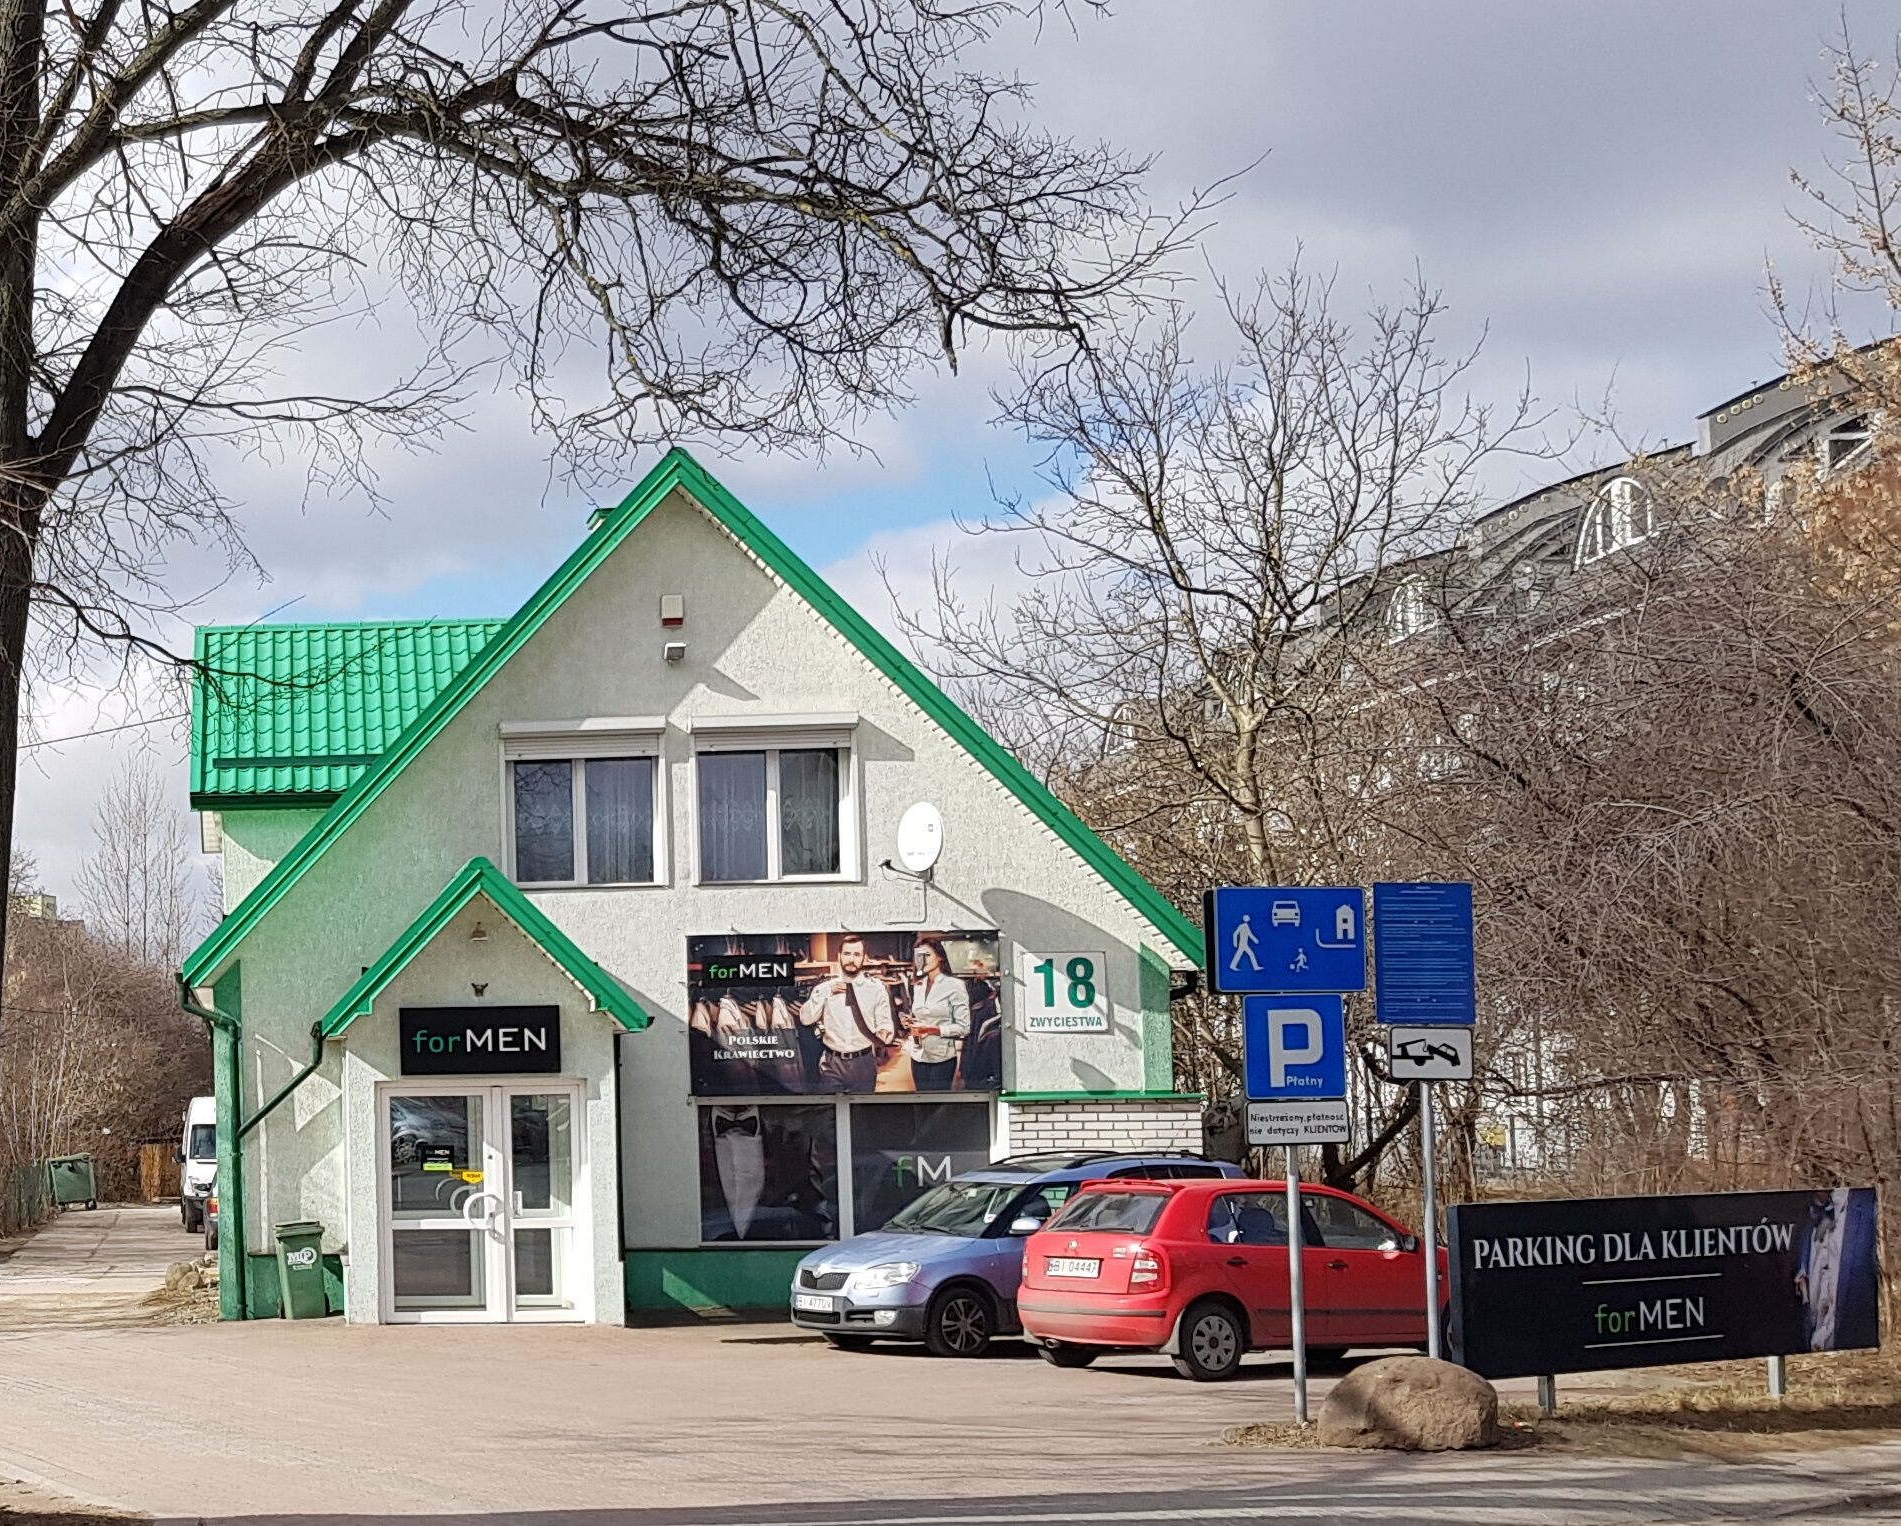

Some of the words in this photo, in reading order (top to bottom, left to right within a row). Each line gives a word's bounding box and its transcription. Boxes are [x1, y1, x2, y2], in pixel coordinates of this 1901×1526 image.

[708, 963, 788, 979] forMEN
[1033, 957, 1096, 1008] 18
[412, 1028, 546, 1053] forMEN
[1267, 1008, 1324, 1088] P
[1286, 1075, 1324, 1088] Płatny
[1266, 1126, 1299, 1136] dotyczy
[1473, 1234, 1597, 1269] PARKING
[1603, 1231, 1656, 1263] DLA
[1661, 1216, 1795, 1259] KLIENTÓW
[1595, 1297, 1705, 1334] forMEN
